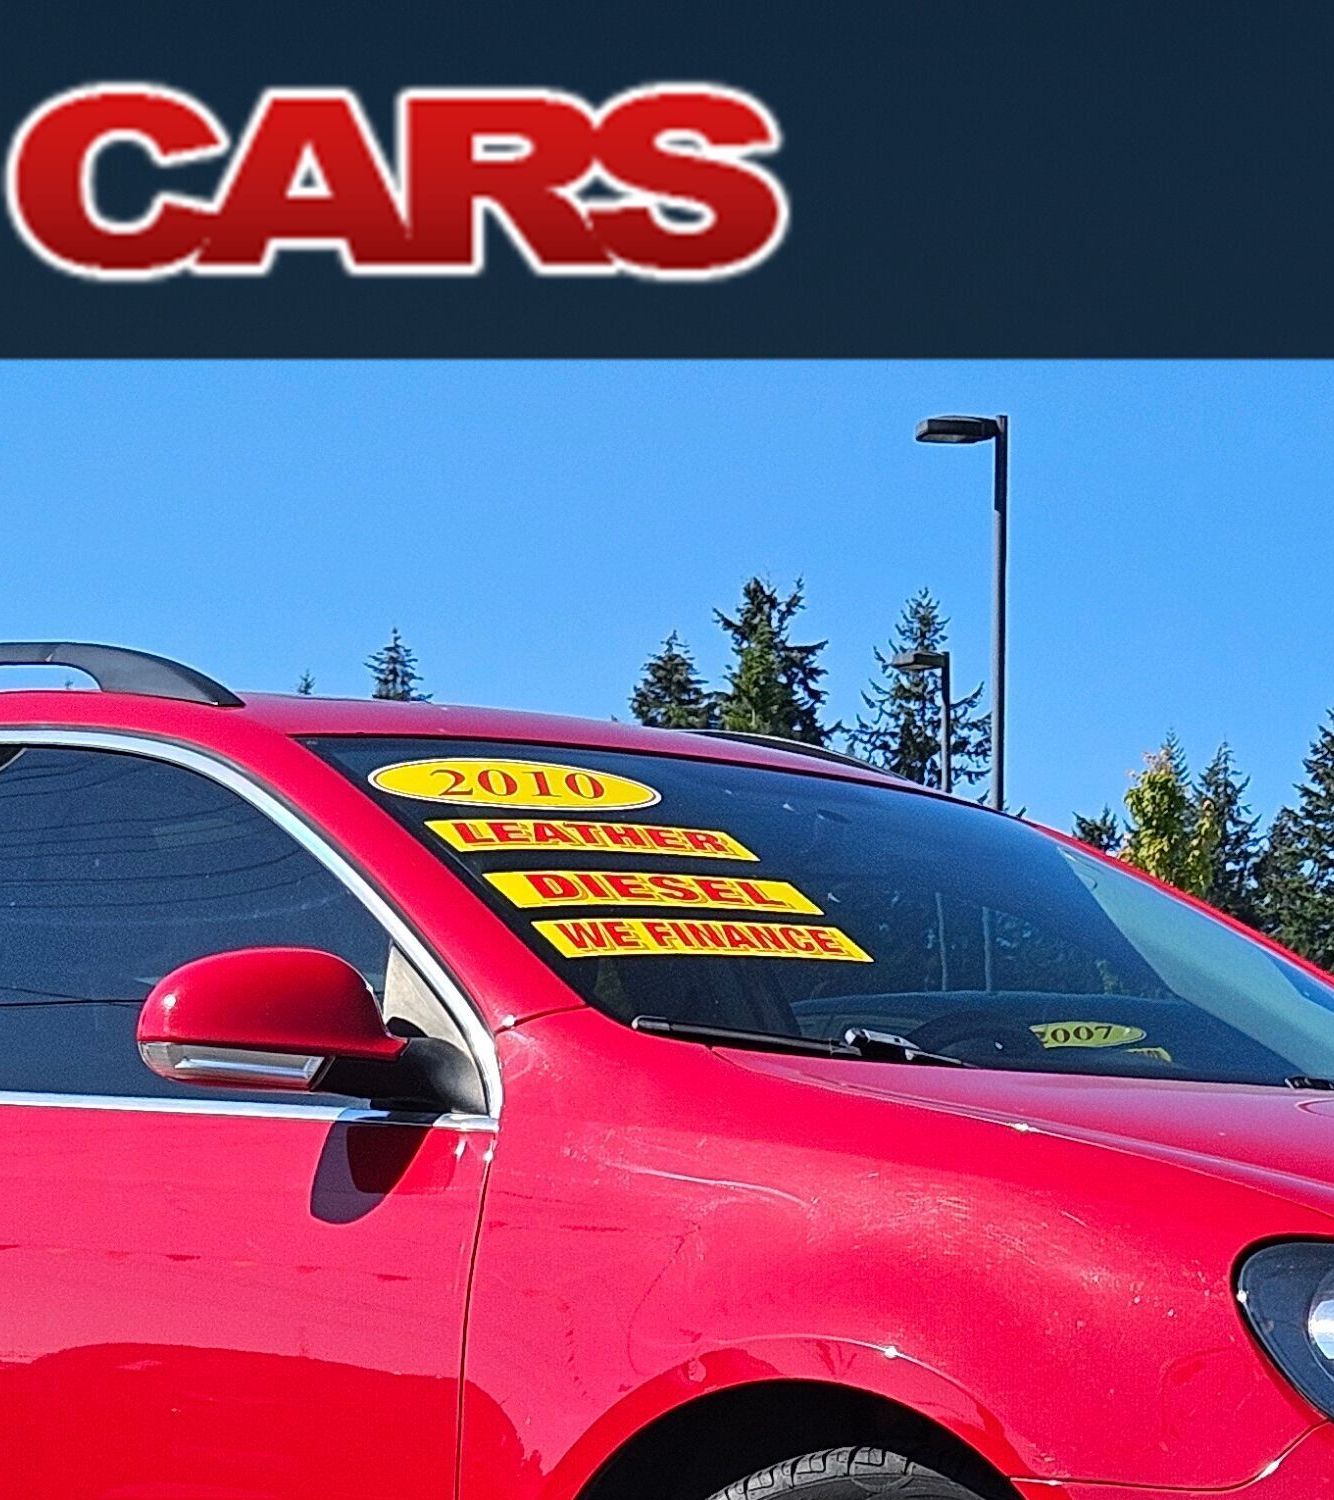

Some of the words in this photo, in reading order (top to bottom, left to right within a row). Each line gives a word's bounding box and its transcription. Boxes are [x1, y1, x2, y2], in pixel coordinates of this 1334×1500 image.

[430, 768, 606, 800] 2010
[451, 821, 737, 854] LEATHER
[523, 873, 791, 907] DIESEL
[555, 920, 647, 953] WE
[644, 920, 851, 956] FINANCE
